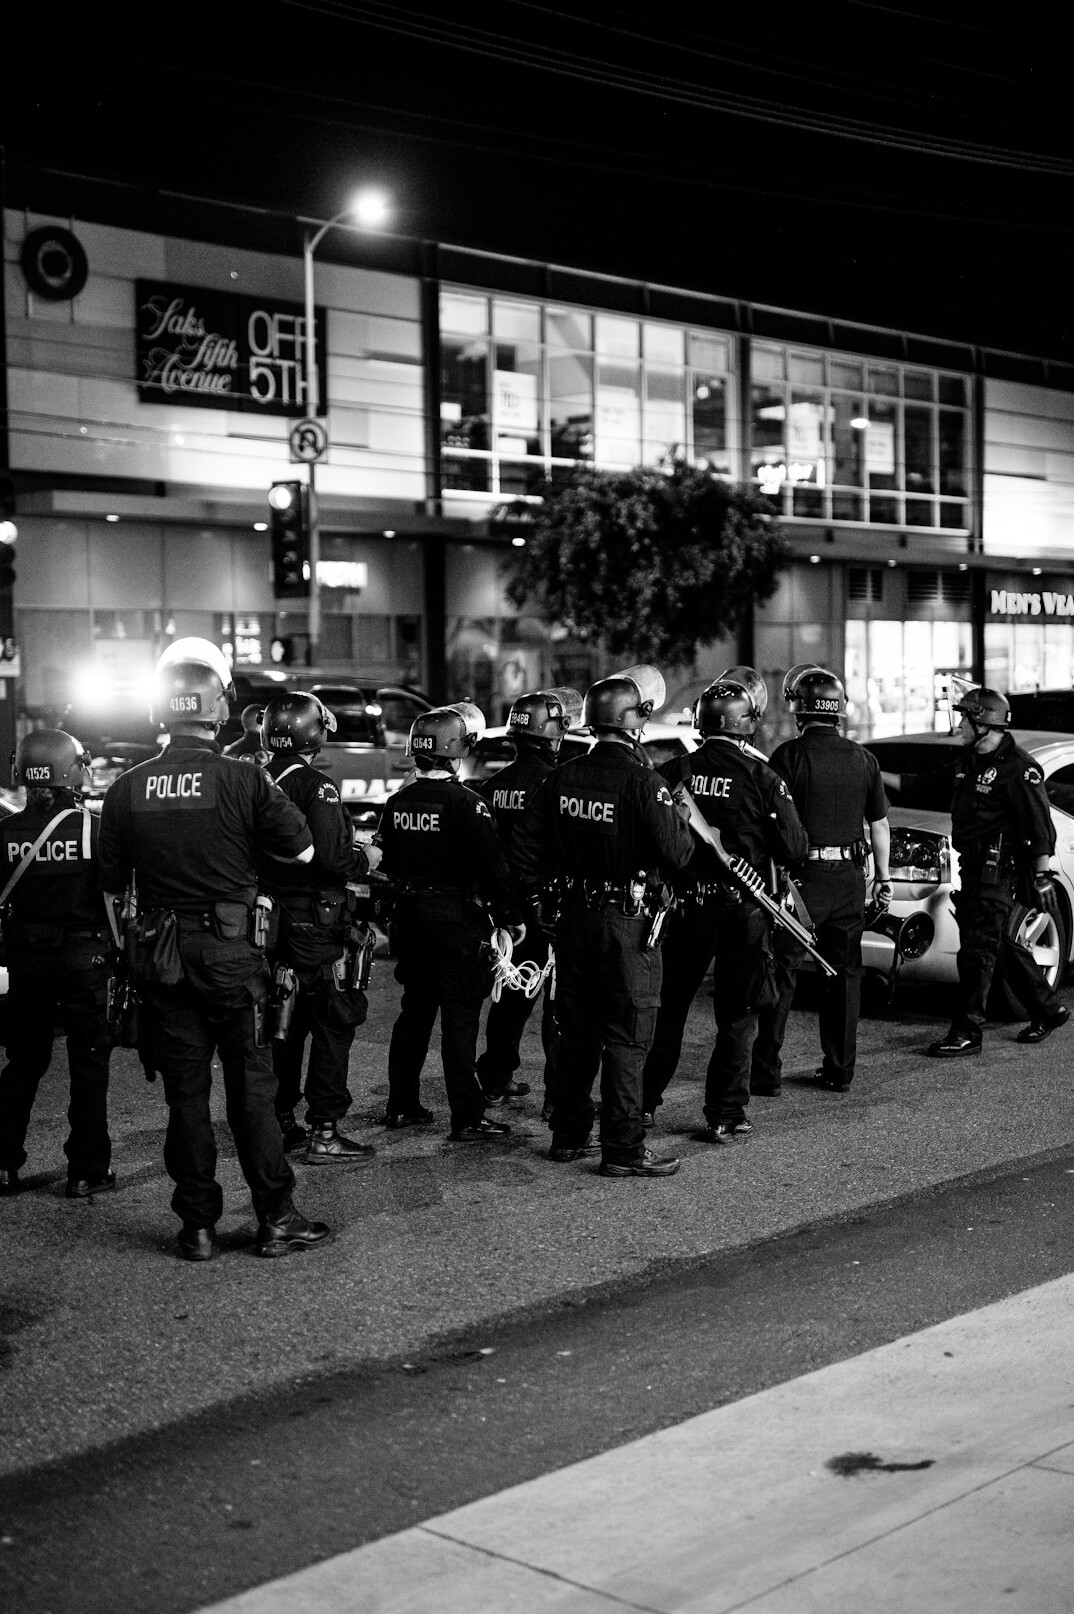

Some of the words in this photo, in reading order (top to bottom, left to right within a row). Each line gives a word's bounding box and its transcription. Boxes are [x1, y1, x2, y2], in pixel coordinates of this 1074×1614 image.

[142, 295, 205, 341] Saks
[248, 310, 319, 359] OFF
[176, 333, 238, 371] Fifth
[143, 347, 232, 394] Avenue
[249, 356, 319, 406] 5TH
[991, 590, 1041, 615] MEN'S
[169, 696, 197, 711] 41636
[815, 699, 839, 711] 33905
[412, 737, 433, 749] 41643
[25, 766, 50, 780] 41525
[146, 772, 202, 799] POLICE
[493, 789, 526, 810] POLICE
[559, 796, 615, 823] POLICE
[393, 811, 441, 832] POLICE
[8, 840, 78, 863] POLICE
